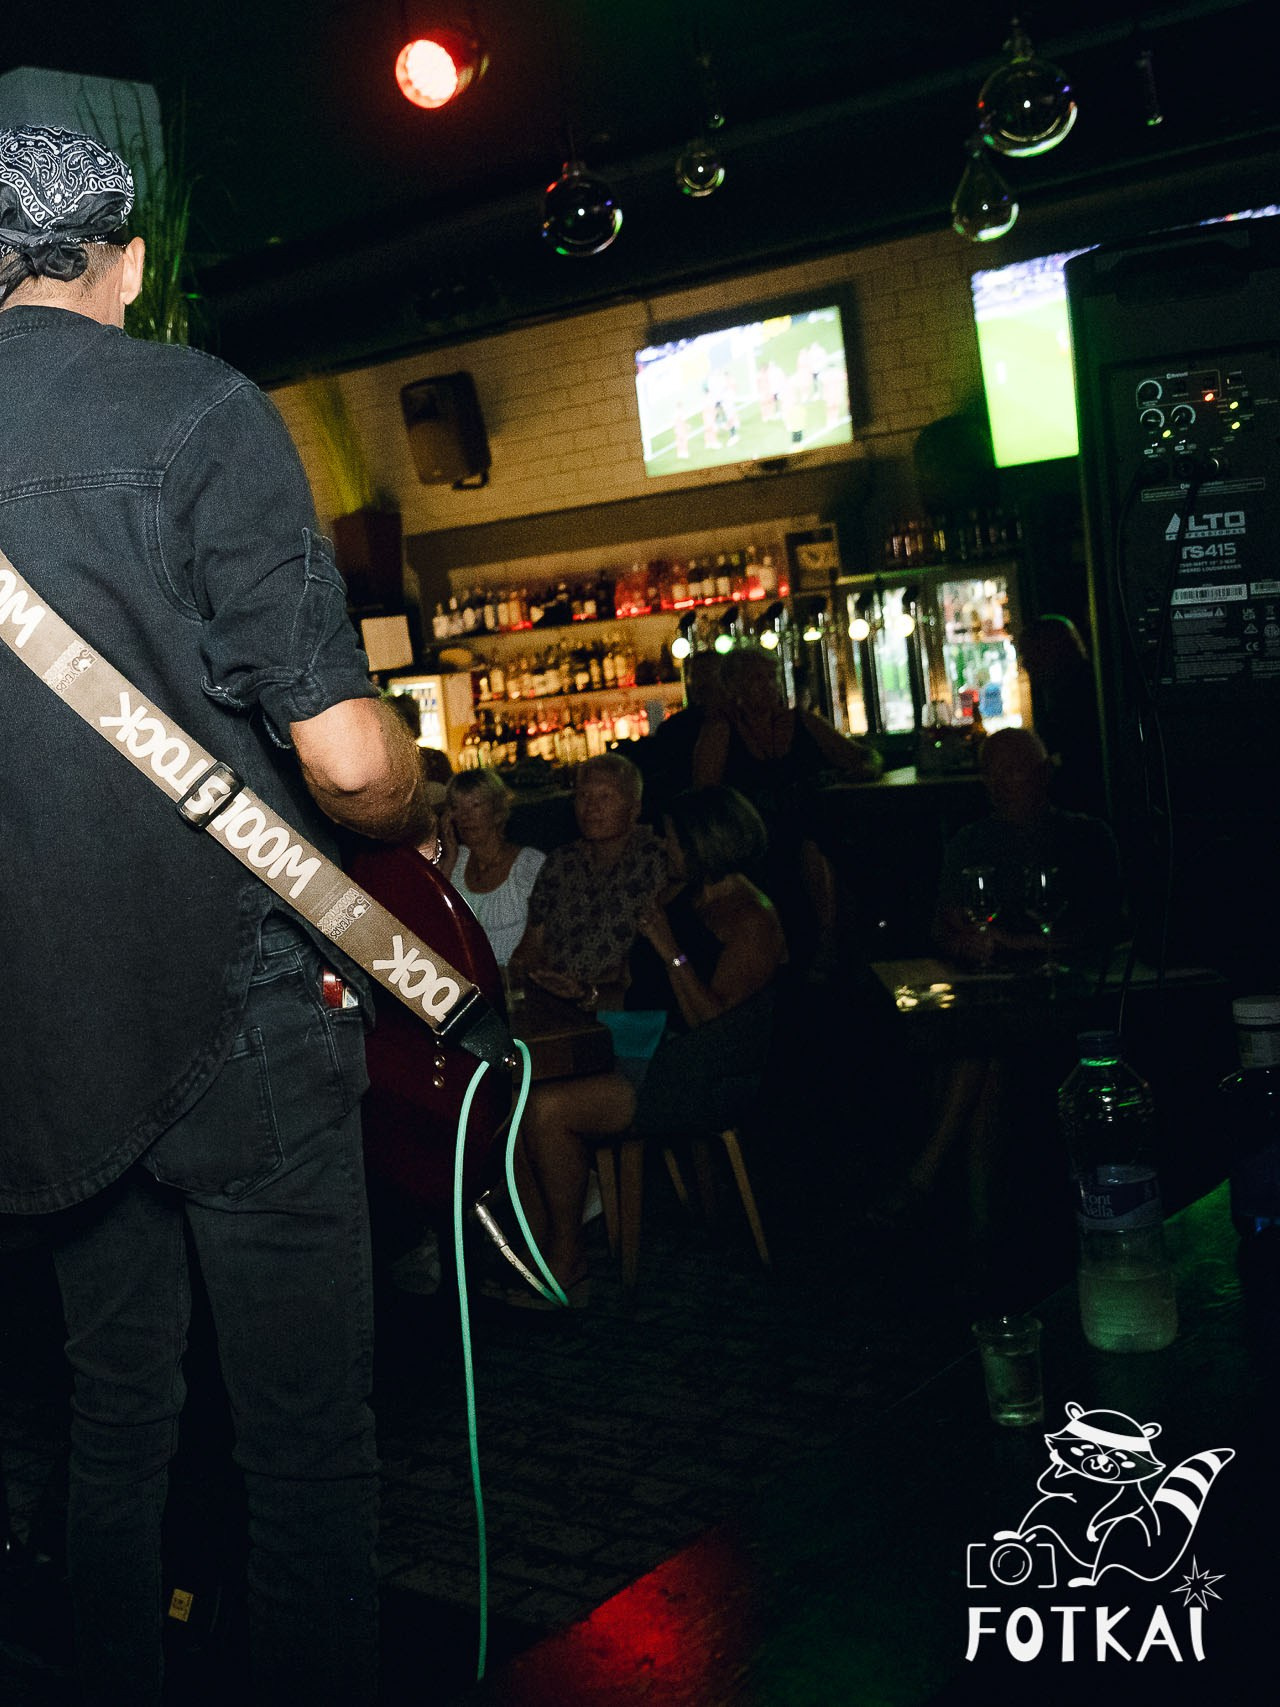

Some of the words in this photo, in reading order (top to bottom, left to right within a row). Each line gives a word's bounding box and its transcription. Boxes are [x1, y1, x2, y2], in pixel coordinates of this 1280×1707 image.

[55, 671, 79, 694] YEARS
[329, 916, 354, 940] YEARS
[373, 935, 460, 1023] OCK
